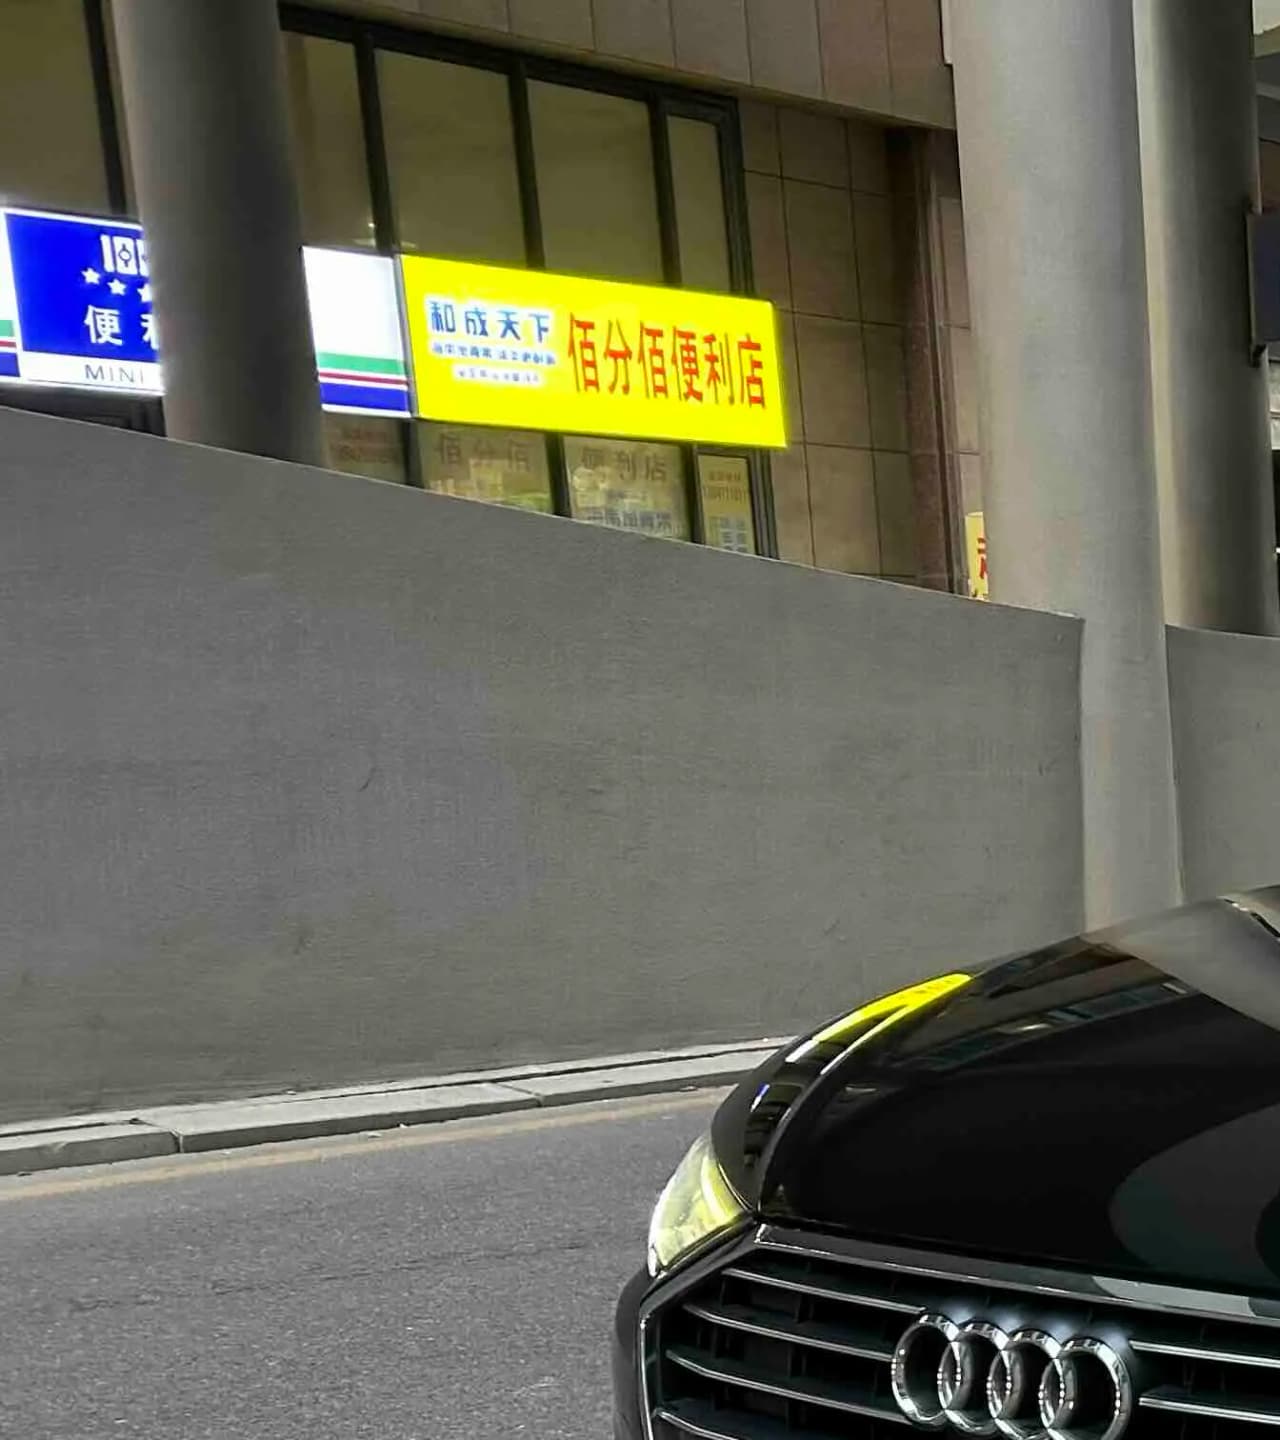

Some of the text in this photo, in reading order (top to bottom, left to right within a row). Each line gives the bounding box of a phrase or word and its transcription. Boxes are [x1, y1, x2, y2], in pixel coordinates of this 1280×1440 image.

[429, 300, 550, 344] 和成天下
[85, 364, 144, 383] MINI
[568, 312, 767, 410] 佰分佰便利店
